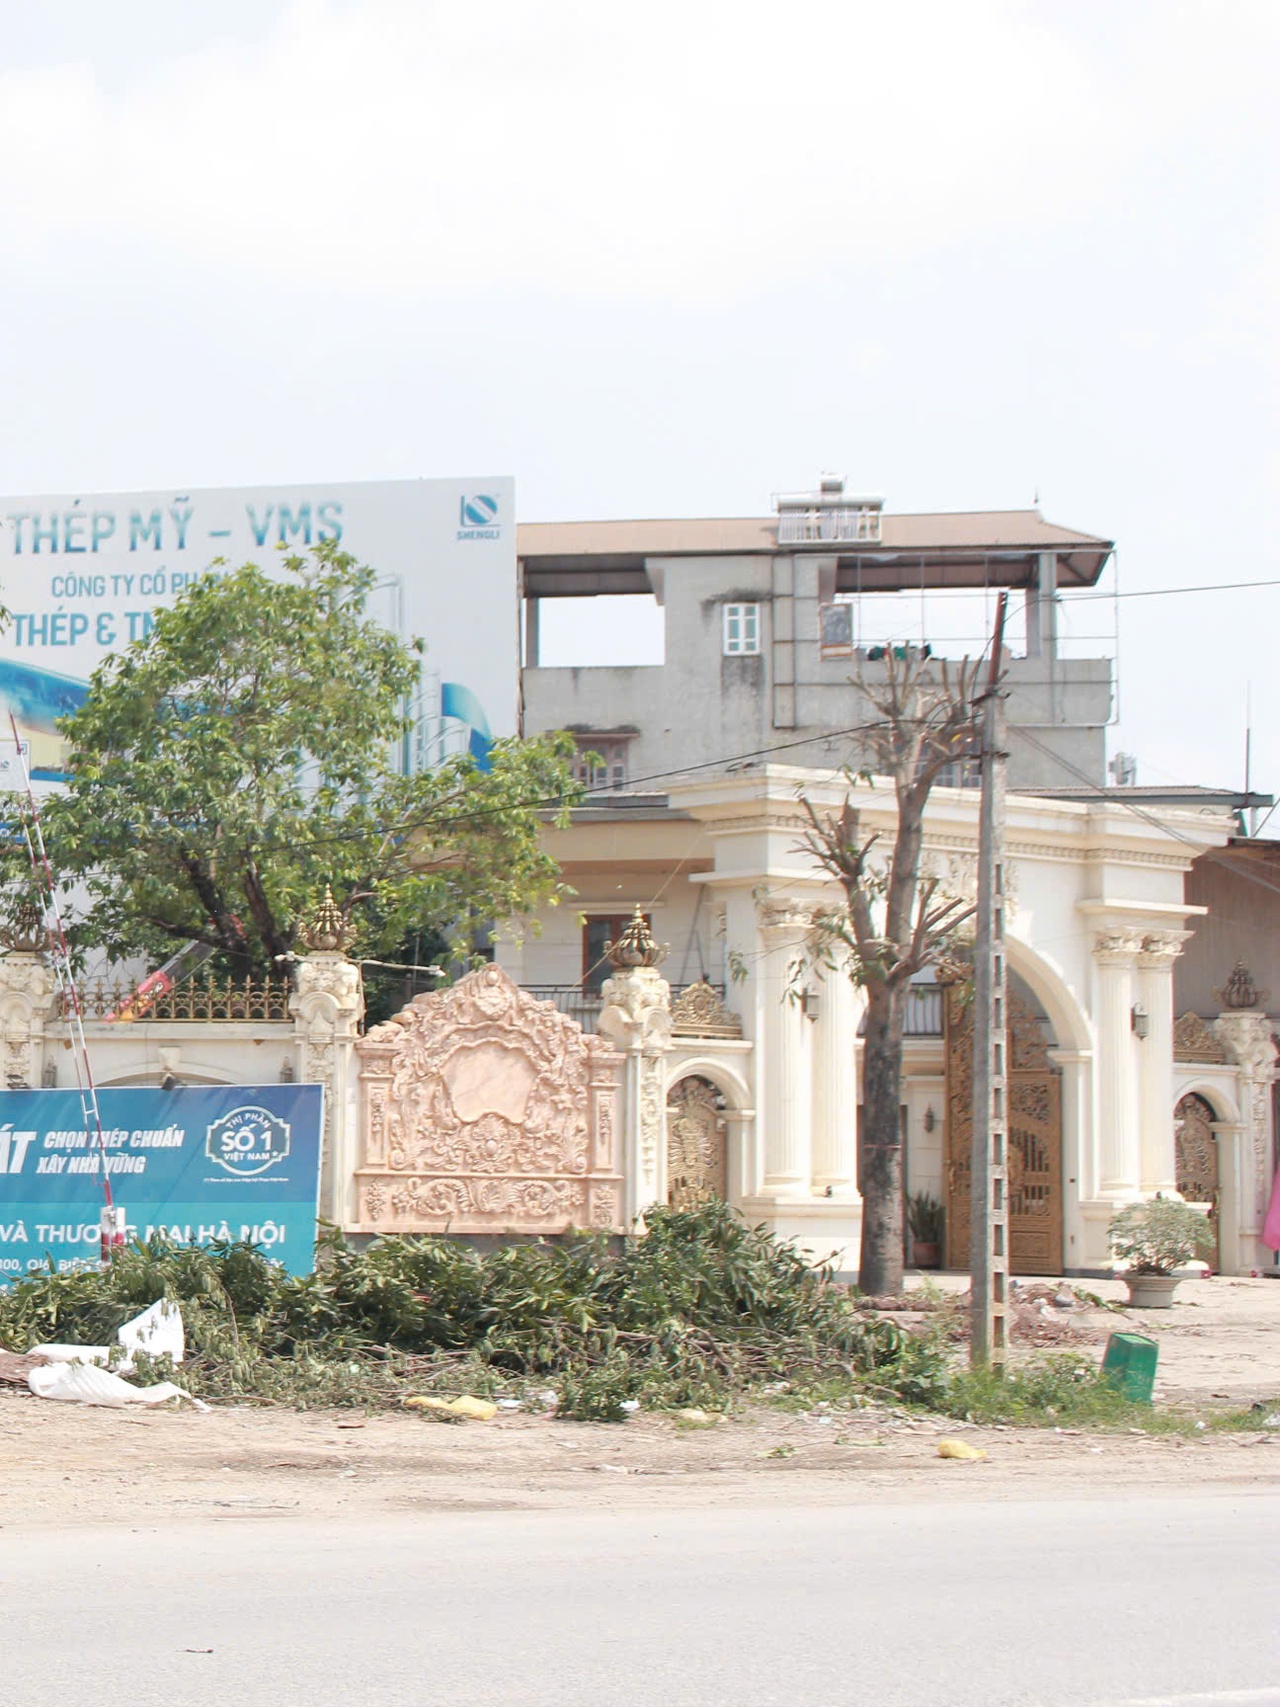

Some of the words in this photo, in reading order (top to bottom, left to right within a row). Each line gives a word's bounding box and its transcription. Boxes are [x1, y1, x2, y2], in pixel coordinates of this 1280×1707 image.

[7, 499, 117, 554] THÉP
[129, 496, 195, 552] MỸ
[245, 501, 343, 546] VMS
[51, 571, 106, 598] CÔNG
[111, 574, 135, 597] TY
[11, 605, 90, 647] THÉP
[96, 611, 117, 645] &
[226, 1114, 243, 1130] THỊ
[44, 1130, 88, 1153] CHỌN
[90, 1127, 130, 1149] THÉP
[220, 1123, 257, 1151] SỐ
[261, 1131, 272, 1151] 1
[35, 1153, 68, 1174] XÂY
[67, 1153, 101, 1174] NHÀ
[103, 1151, 147, 1174] VỮNG
[224, 1151, 245, 1162] VIỆT
[247, 1152, 270, 1161] NAM
[240, 1220, 286, 1249] NỘI
